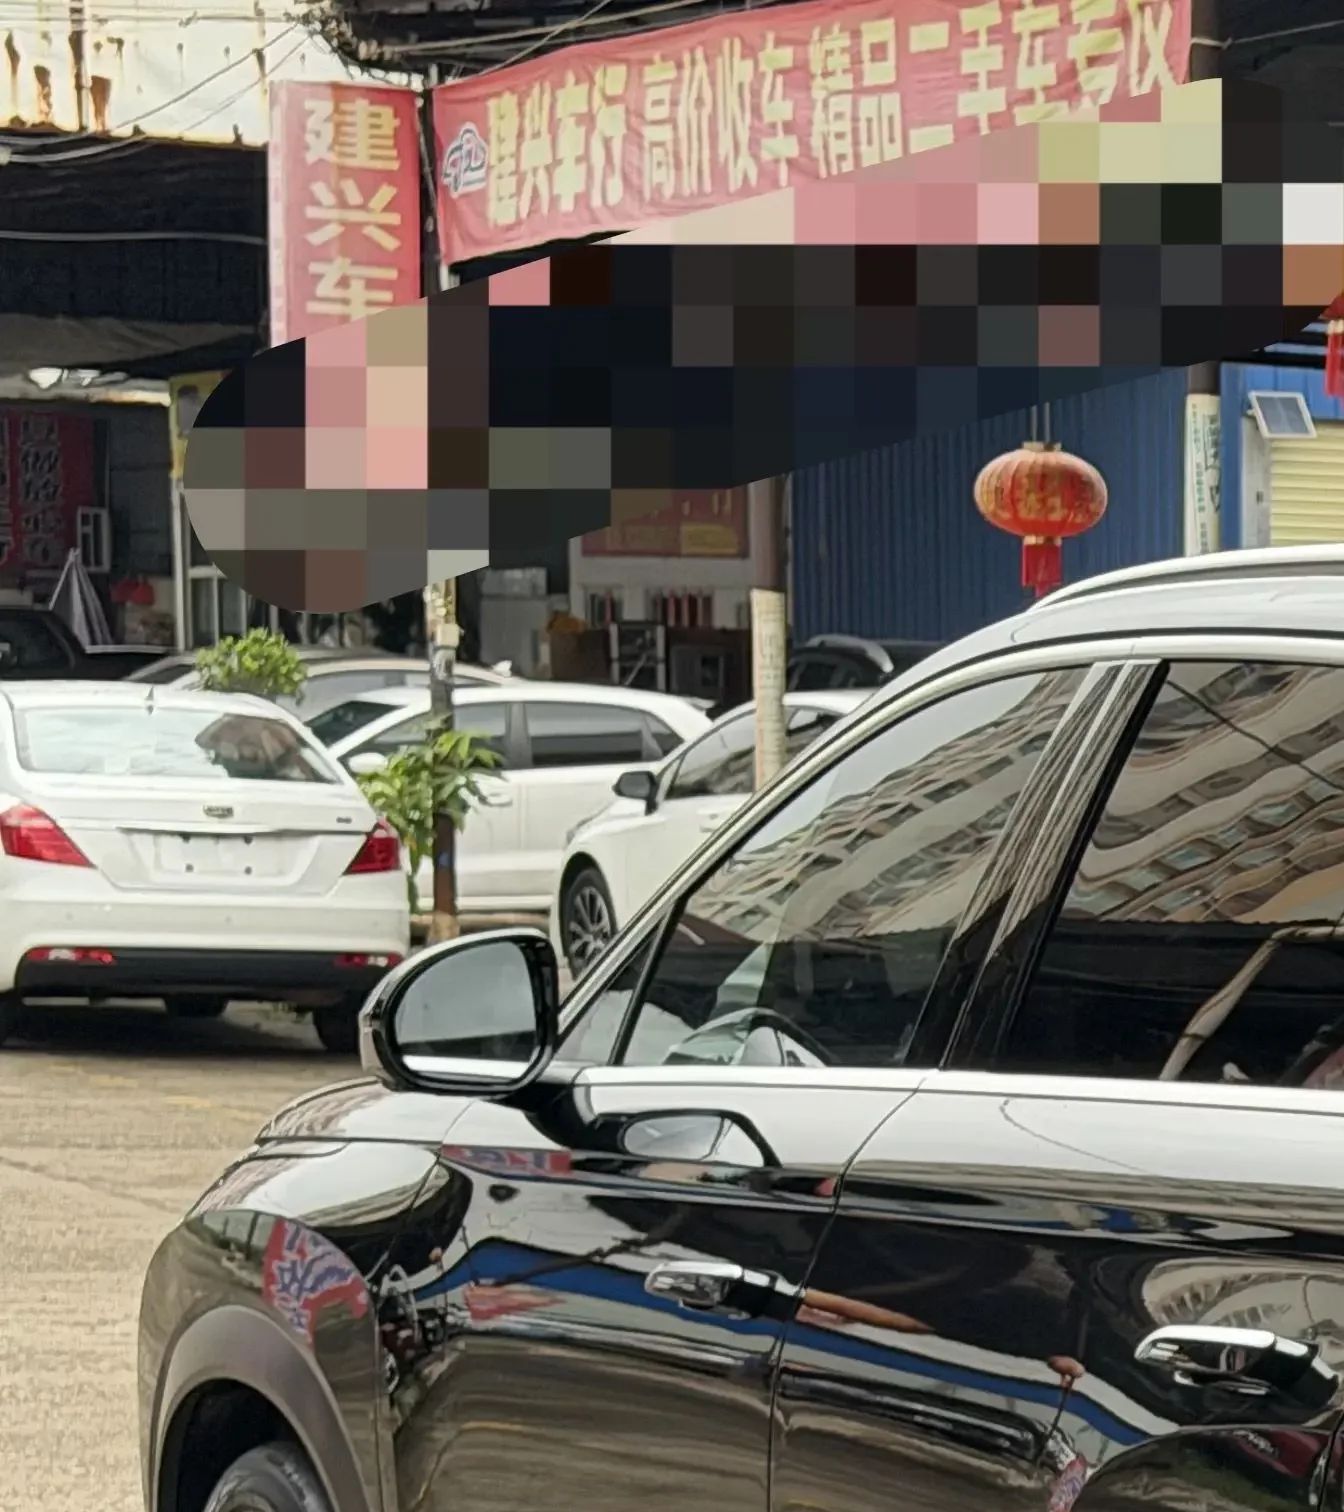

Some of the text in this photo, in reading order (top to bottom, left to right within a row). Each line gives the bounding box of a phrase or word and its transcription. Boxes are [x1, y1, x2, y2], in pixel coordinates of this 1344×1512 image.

[304, 99, 401, 320] 建兴车
[643, 31, 800, 202] 高价收车
